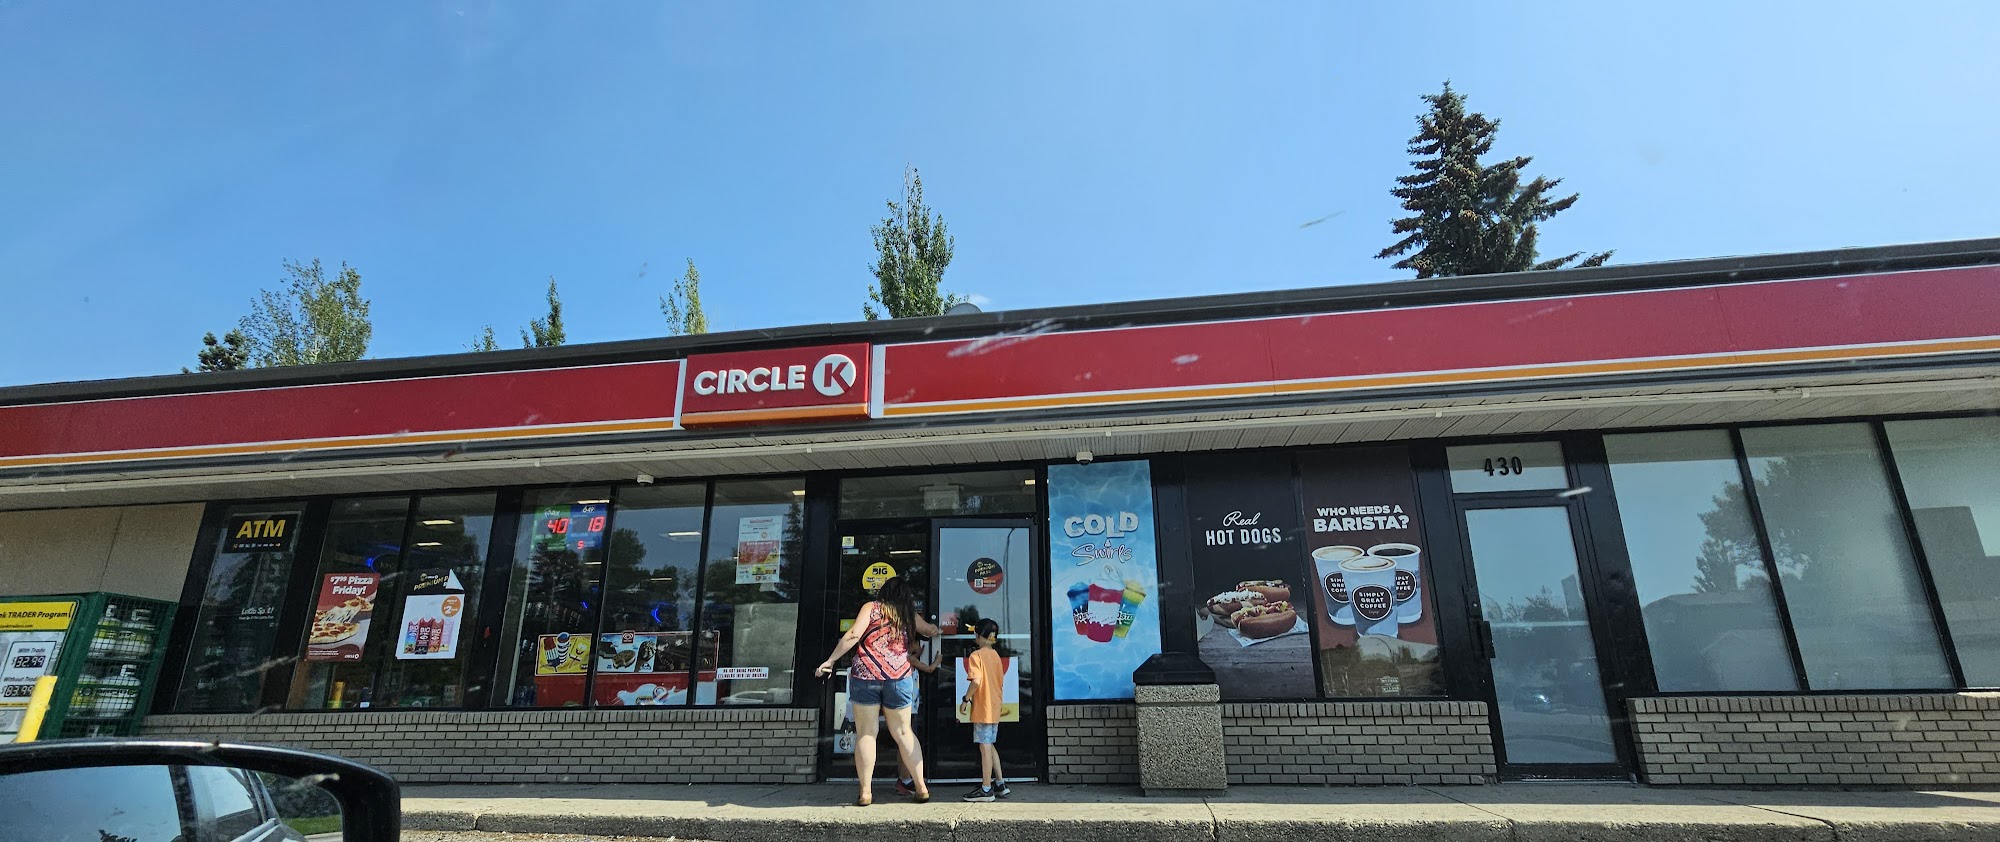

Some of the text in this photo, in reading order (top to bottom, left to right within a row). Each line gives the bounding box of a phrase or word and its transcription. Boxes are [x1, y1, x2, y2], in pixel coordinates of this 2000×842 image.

[693, 364, 807, 396] CIRCLE
[1484, 456, 1523, 476] 430
[1223, 510, 1261, 527] Real
[1316, 504, 1403, 517] WHO NEEDS A
[235, 519, 287, 539] ATM
[547, 517, 570, 534] 40
[587, 515, 606, 533] 18
[1064, 511, 1139, 538] COLD
[1313, 515, 1410, 533] BARISTA?
[1205, 527, 1282, 546] HOT DOGS
[1071, 540, 1132, 566] Swirls
[347, 575, 374, 585] Pizza
[872, 567, 888, 575] BIG
[332, 585, 367, 596] Friday!
[8, 611, 37, 619] TRADER
[37, 610, 68, 620] Program
